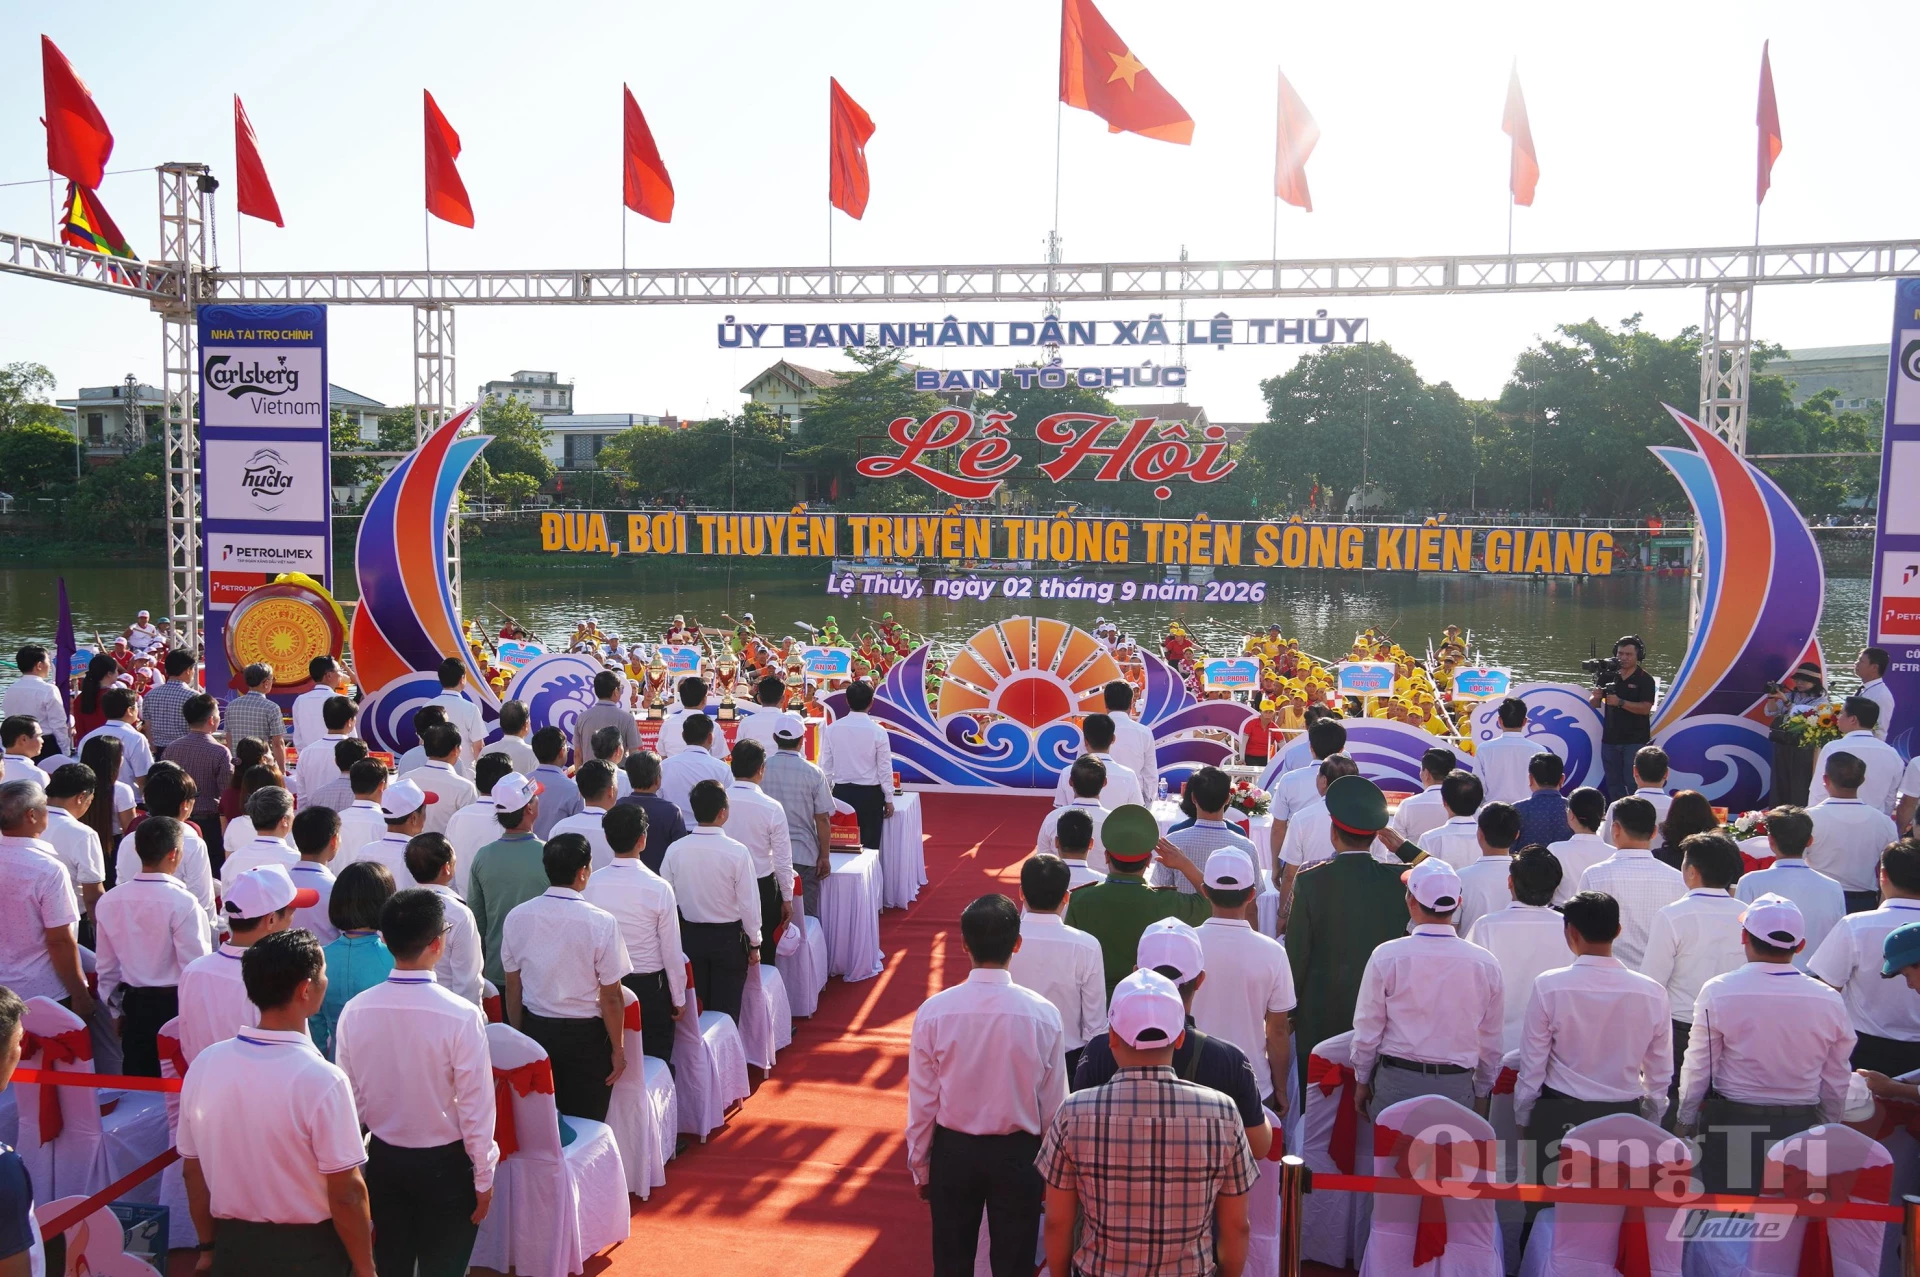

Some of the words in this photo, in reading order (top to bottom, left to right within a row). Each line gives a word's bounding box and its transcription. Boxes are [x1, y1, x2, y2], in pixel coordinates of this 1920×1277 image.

[211, 328, 235, 340] NHÀ
[237, 328, 255, 340] TÀI
[257, 329, 280, 341] TRỢ
[281, 328, 314, 340] CHÍNH
[717, 315, 770, 348] ỦY
[783, 322, 865, 348] BAN
[879, 314, 995, 348] NHÂN
[1009, 313, 1097, 347] DÂN
[1112, 313, 1171, 346] XÃ
[1186, 312, 1233, 351] LỆ
[1250, 309, 1368, 345] THỦY
[205, 355, 300, 397] Carlsberg
[916, 368, 1000, 392] BAN
[1014, 356, 1066, 391] TỔ
[1077, 358, 1187, 389] CHỨC
[251, 397, 321, 415] Vietnam
[856, 408, 1022, 500] Lễ
[1036, 409, 1236, 501] Hội
[242, 465, 294, 490] huda
[237, 547, 313, 559] PETROLIMEX
[540, 510, 622, 558] ĐUA,
[628, 506, 690, 555] BƠI
[696, 502, 838, 557] THUYỀN
[848, 503, 992, 559] TRUYỀN
[1003, 505, 1131, 564] THỐNG
[1142, 512, 1244, 567] TRÊN
[1254, 514, 1364, 569] SÔNG
[1376, 512, 1474, 573] KIẾN
[1484, 529, 1614, 576] GIANG
[826, 571, 856, 599] Lệ
[861, 569, 925, 600] Thủy,
[933, 573, 997, 601] ngày
[1002, 577, 1032, 599] 02
[1039, 576, 1117, 603] tháng
[1120, 580, 1137, 600] 9
[1142, 579, 1199, 602] năm
[1204, 580, 1267, 602] 2026
